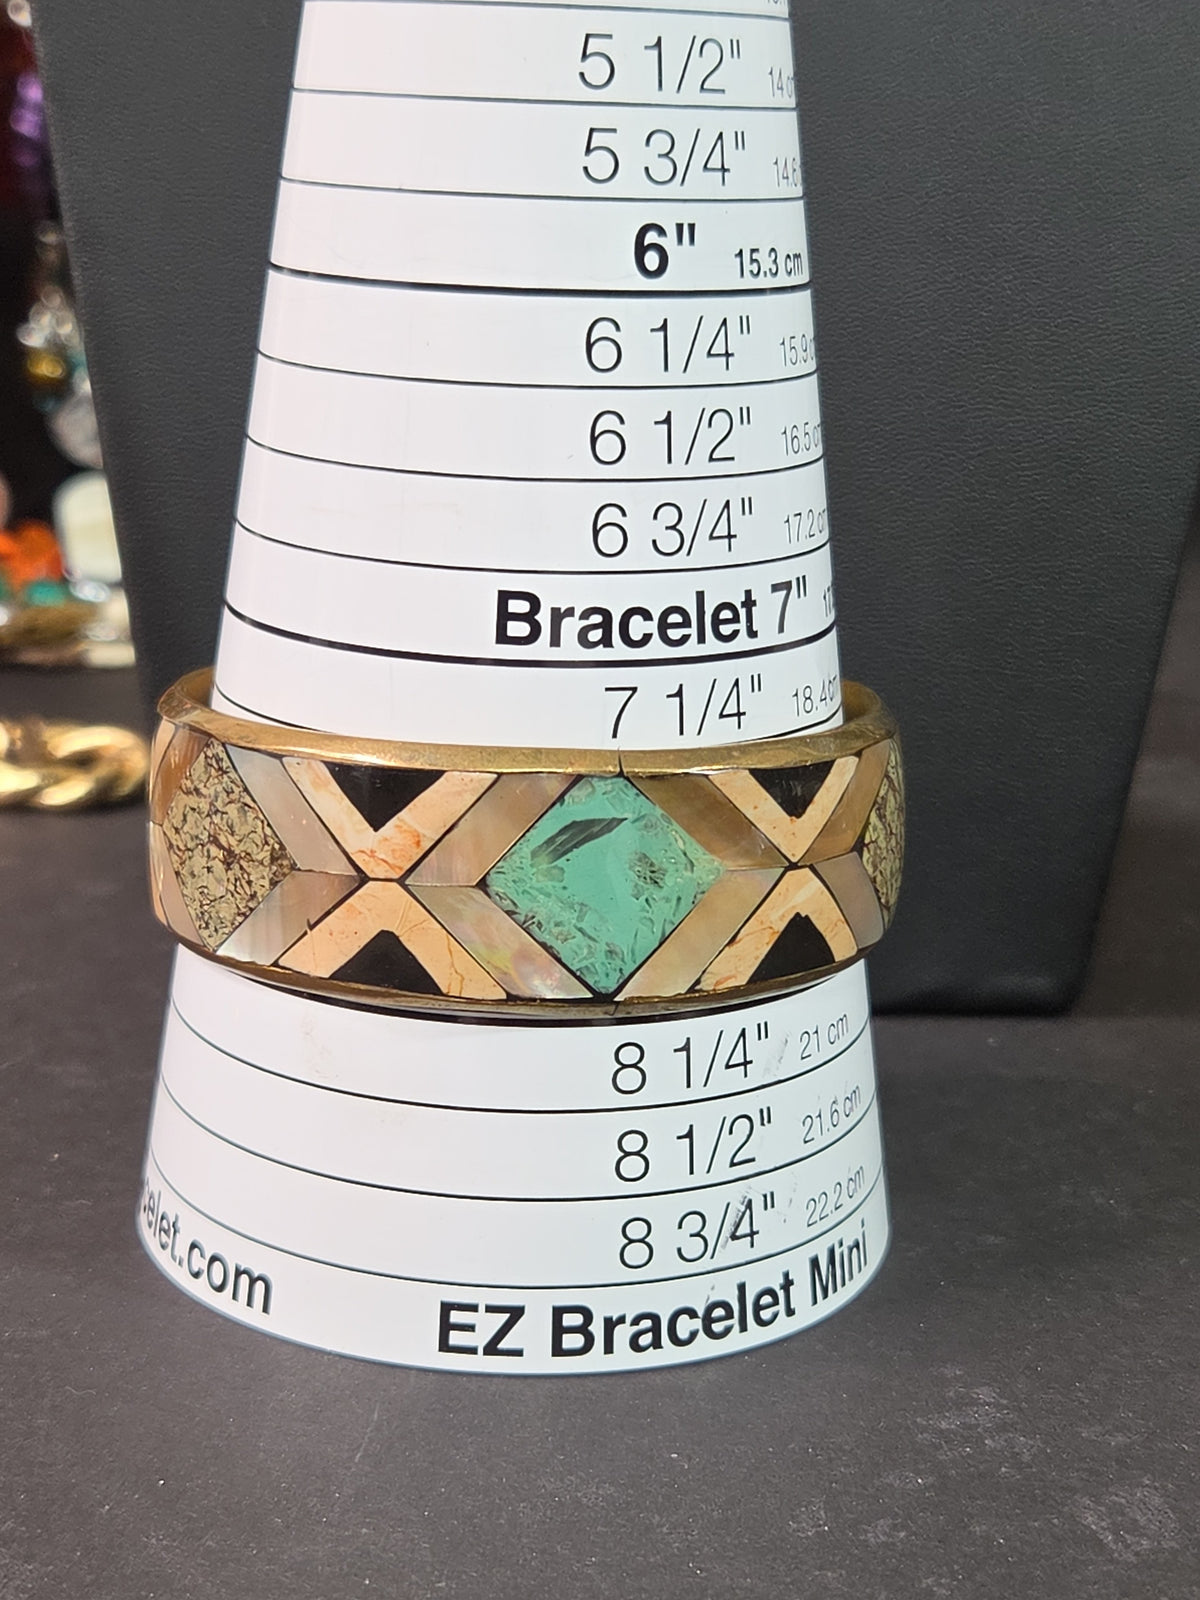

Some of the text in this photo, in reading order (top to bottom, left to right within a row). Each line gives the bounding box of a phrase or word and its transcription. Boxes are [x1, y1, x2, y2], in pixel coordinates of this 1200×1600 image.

[579, 33, 615, 90] 5
[644, 35, 741, 95] 1/2"
[582, 127, 619, 184] 5
[644, 128, 746, 187] 3/4"
[633, 222, 804, 280] 6" 15.3 cm
[585, 317, 623, 373] 6
[650, 314, 751, 374] 1/4"
[779, 333, 808, 367] 15.9
[589, 409, 627, 465] 6
[653, 406, 751, 465] 1/2"
[781, 421, 811, 456] 16.5
[592, 502, 628, 558] 6
[651, 496, 753, 557] 3/4"
[784, 508, 815, 544] 17.2
[495, 588, 758, 649] Bracelet
[770, 574, 807, 634] 7"
[604, 686, 639, 739] 7
[665, 673, 762, 737] 1/4"
[611, 1013, 849, 1095] 8 1/4" 21 cm
[614, 1085, 861, 1182] 8 1/2" 21.6 cm
[619, 1165, 866, 1269] 8 3/4" 22.2 cm
[437, 1219, 869, 1358] EZ Bracelet Mini
